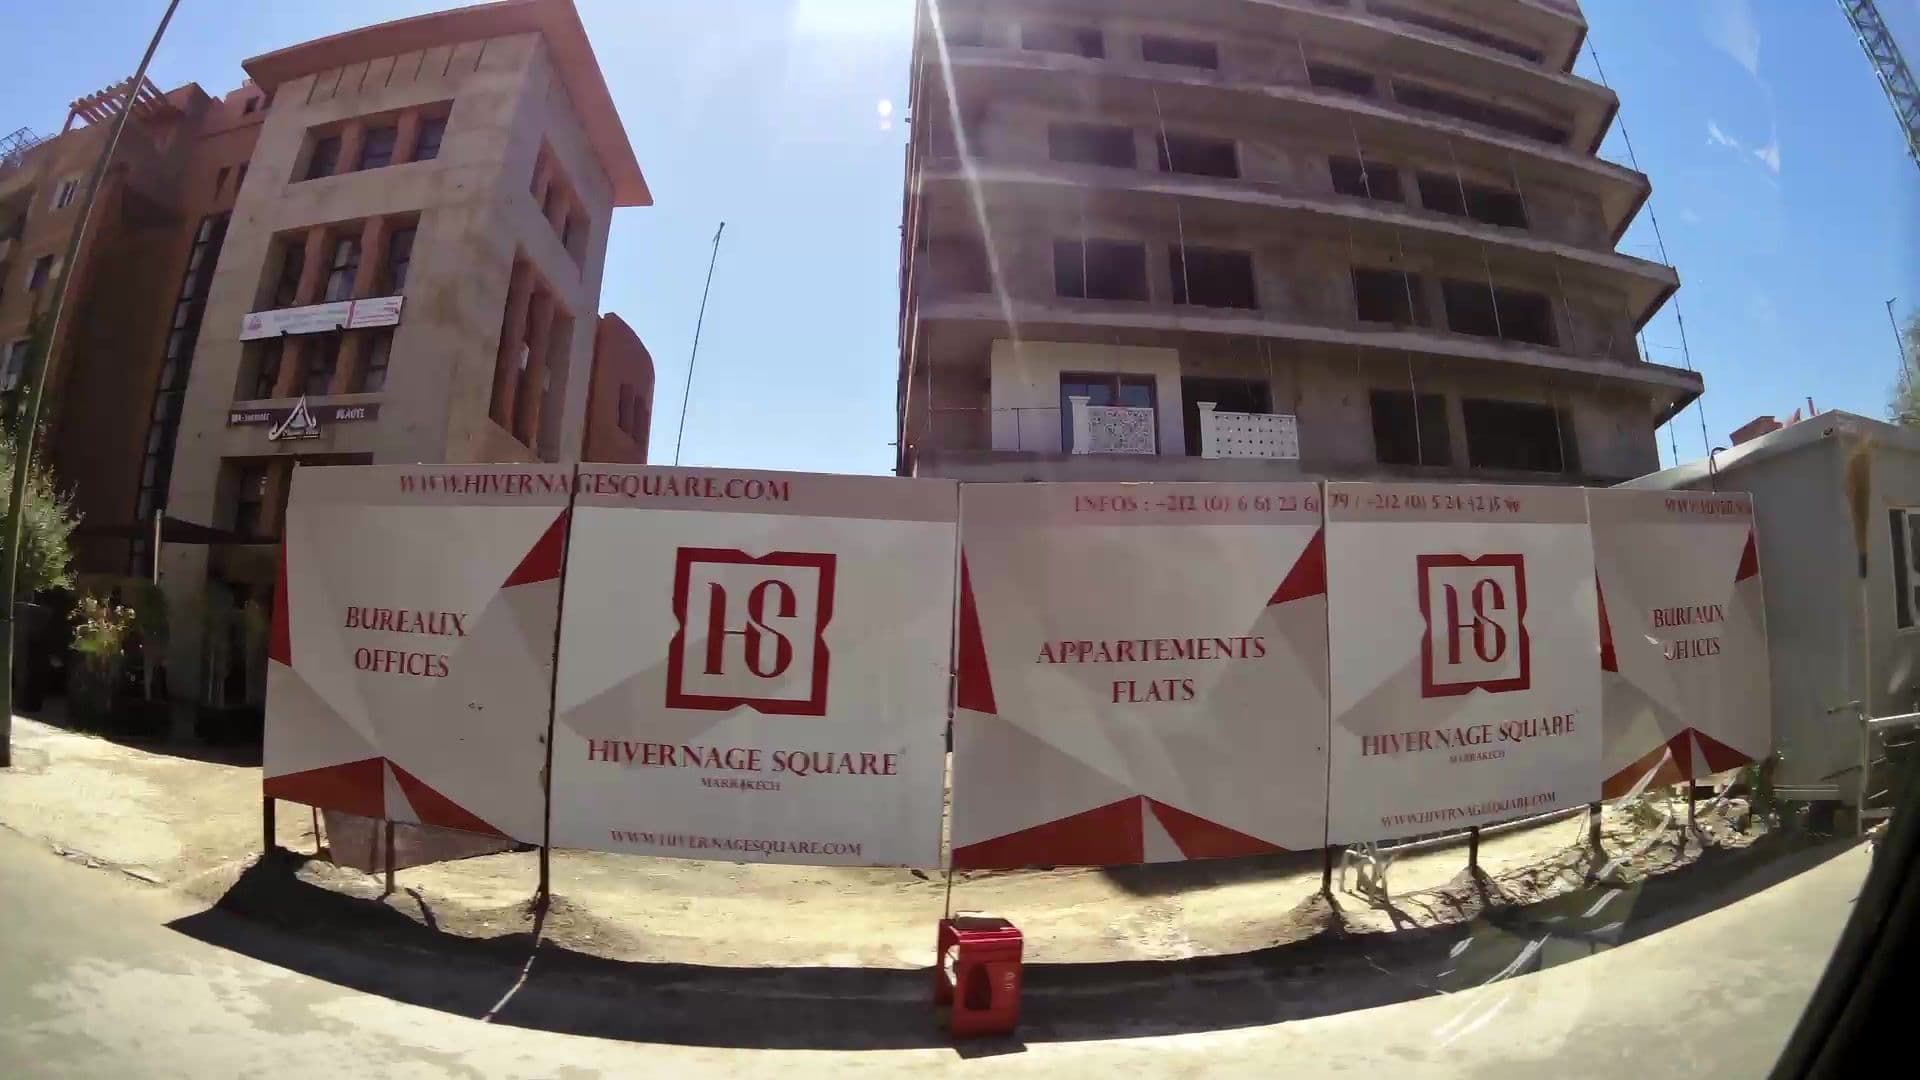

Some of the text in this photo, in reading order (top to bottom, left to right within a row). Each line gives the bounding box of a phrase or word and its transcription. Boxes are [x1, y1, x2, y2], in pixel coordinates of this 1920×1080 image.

[400, 474, 790, 501] WWW.HIVERNAGESQUARE.COM
[1075, 495, 1138, 512] INFOS
[344, 606, 468, 637] BUREAUX
[703, 579, 798, 678] HS
[1442, 578, 1507, 665] HS
[354, 647, 449, 678] OFFICES
[1035, 636, 1266, 663] APPARTEMENTS
[1111, 678, 1195, 704] FLATS
[1361, 713, 1576, 757] HIVERNAGE SQUARE
[586, 739, 898, 777] HIVERNAGE SQUARE
[701, 776, 781, 791] MARRAKECH
